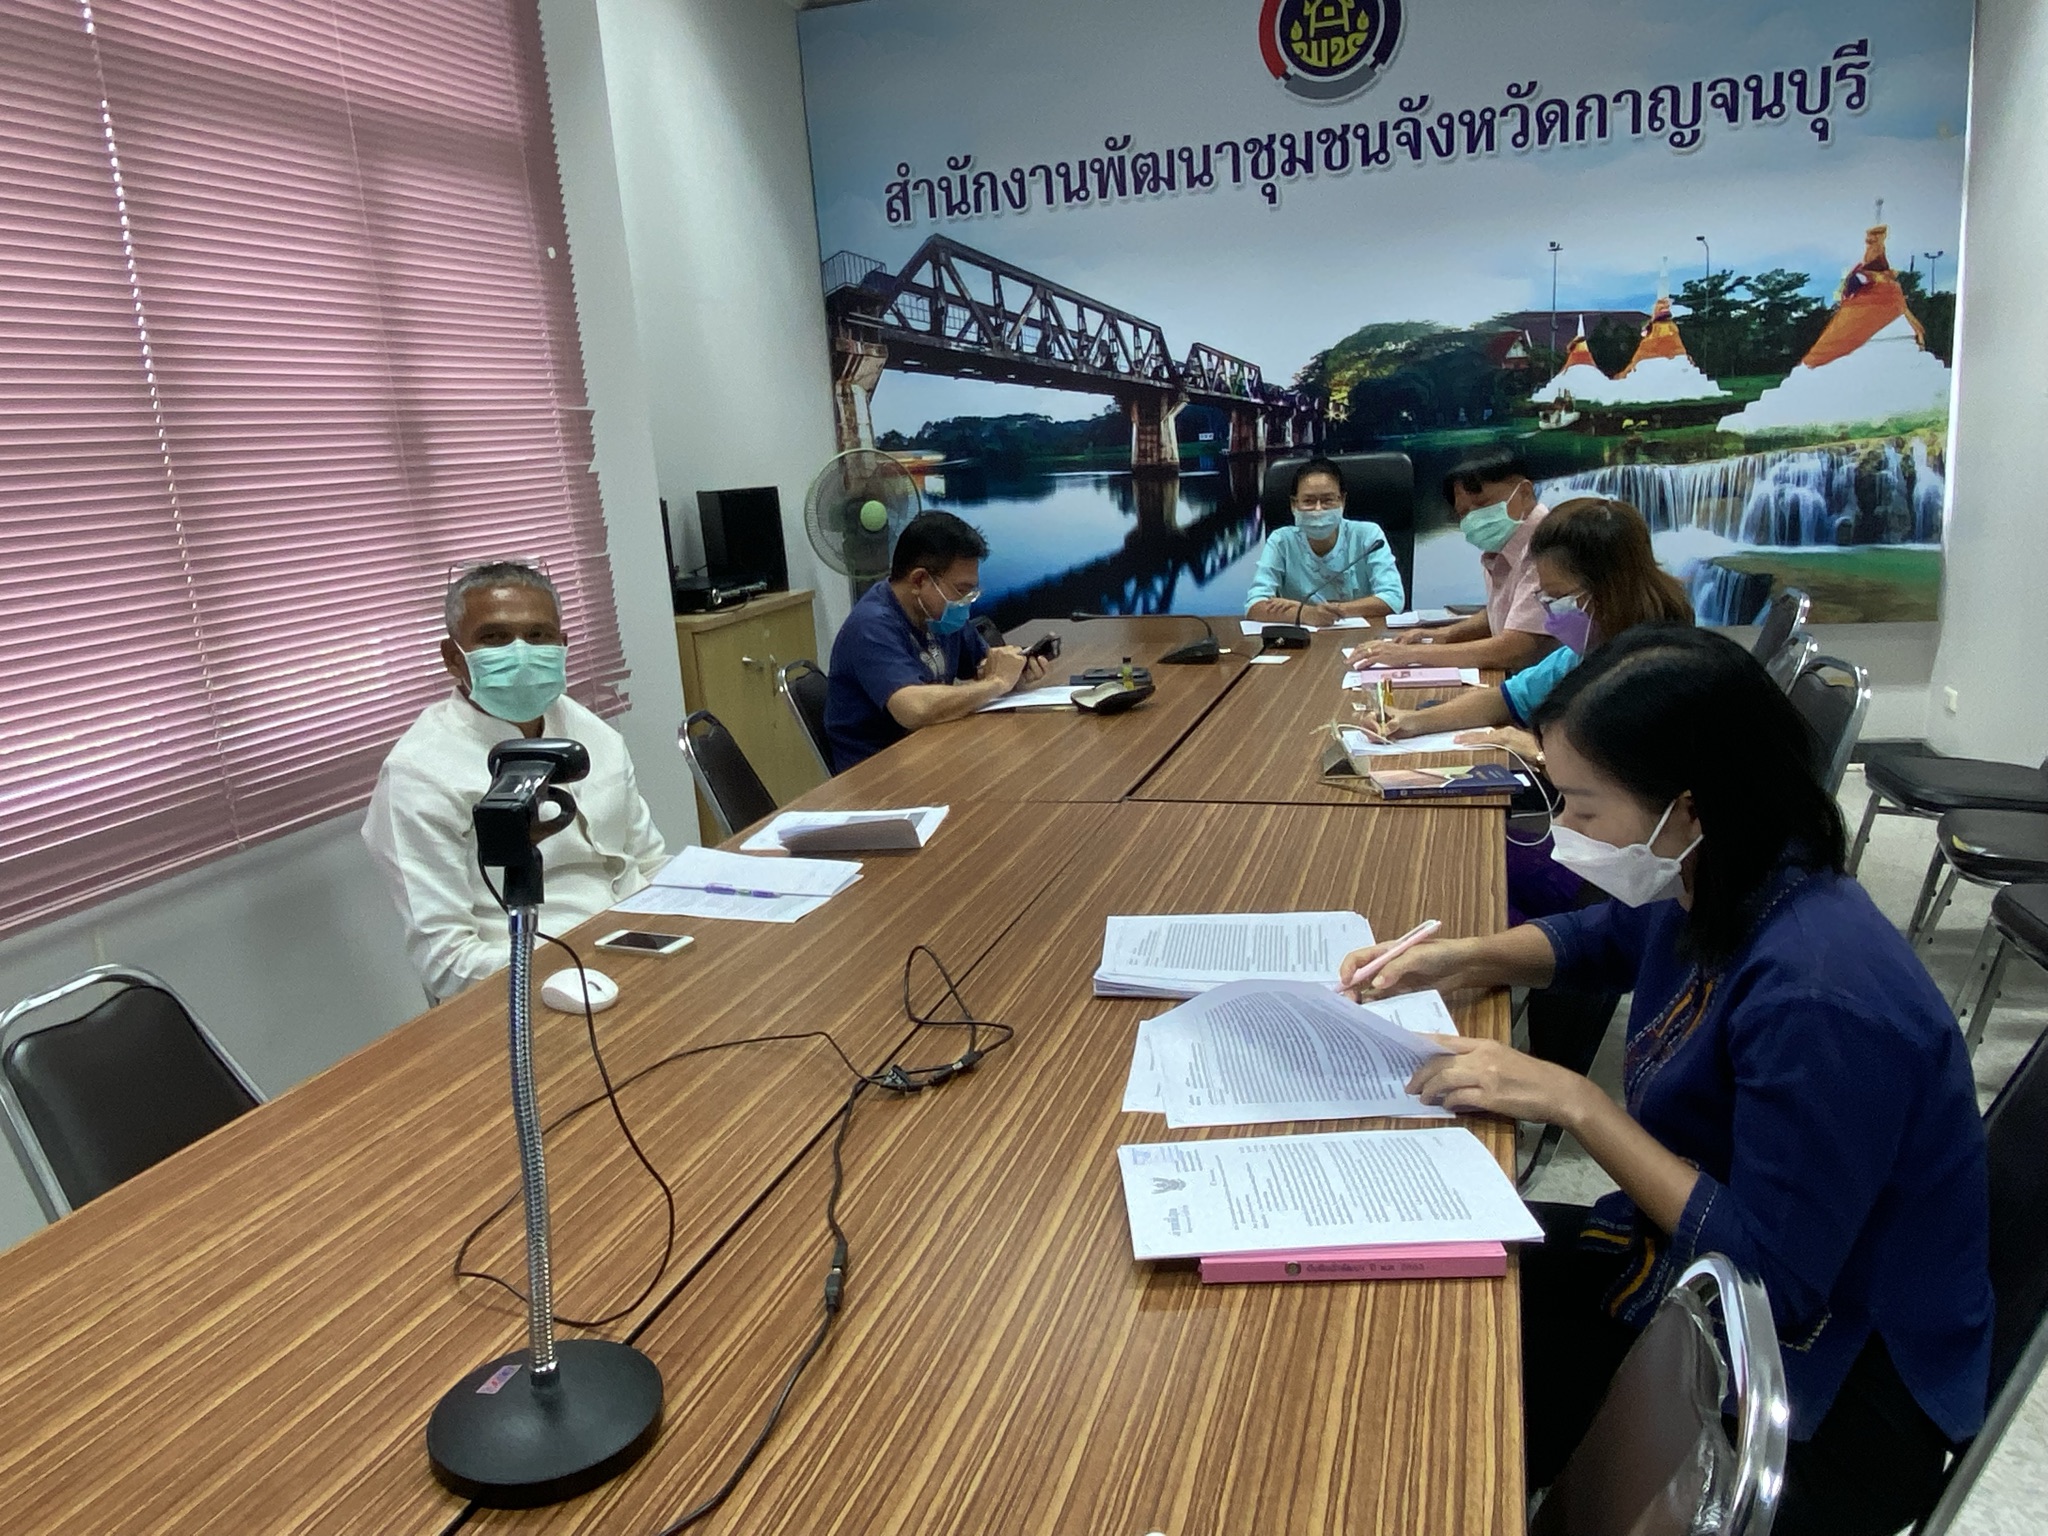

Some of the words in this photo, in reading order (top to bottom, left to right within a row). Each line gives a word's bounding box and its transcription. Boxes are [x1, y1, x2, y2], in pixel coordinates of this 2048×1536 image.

[884, 38, 1871, 224] สำนักงานพัฒนาชุมชนจังหวัดกาญจนบุรี
